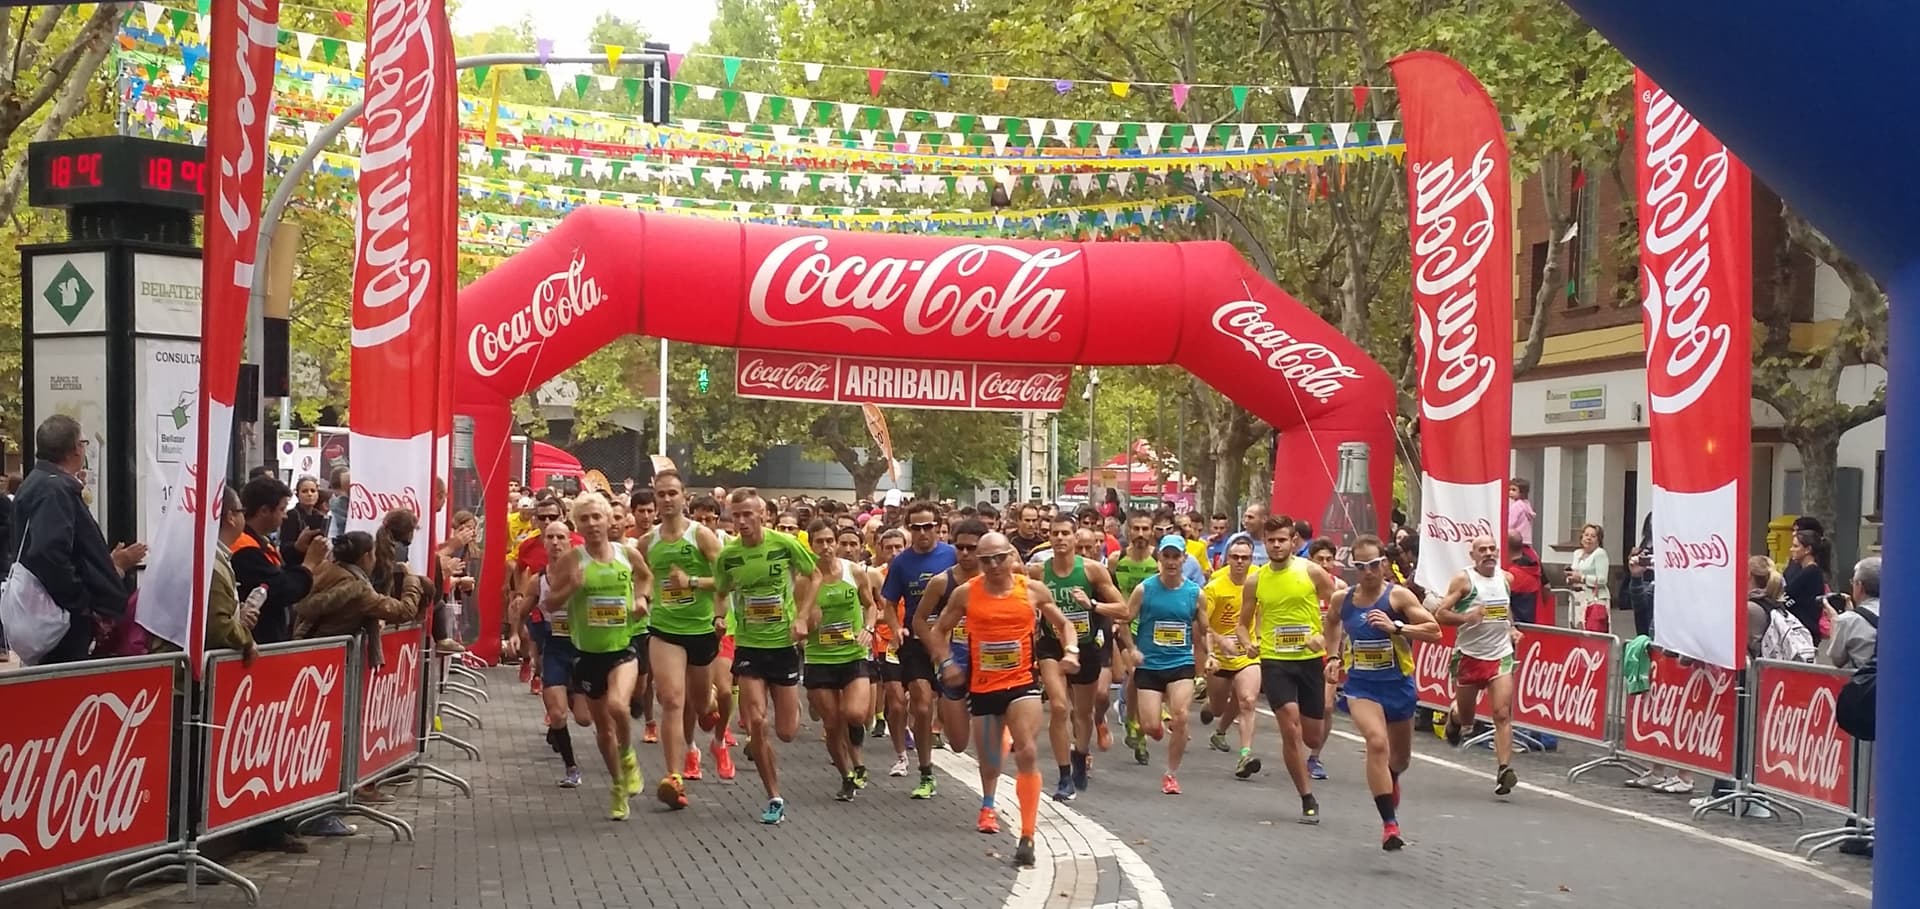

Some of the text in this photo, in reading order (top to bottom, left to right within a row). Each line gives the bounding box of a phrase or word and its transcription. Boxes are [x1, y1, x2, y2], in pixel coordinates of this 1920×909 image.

[52, 156, 71, 189] 18
[149, 158, 172, 191] 18
[468, 253, 602, 377] Coca-Cola
[748, 235, 1079, 341] Coca-Cola
[740, 358, 1069, 403] Coca-Cola ARRIBADA Coca-Cola
[1211, 300, 1364, 400] Coca-Cola
[1518, 641, 1605, 728] Coca-Cola
[1632, 661, 1733, 758] Coca-Cola
[218, 663, 339, 808] Coca-Cola
